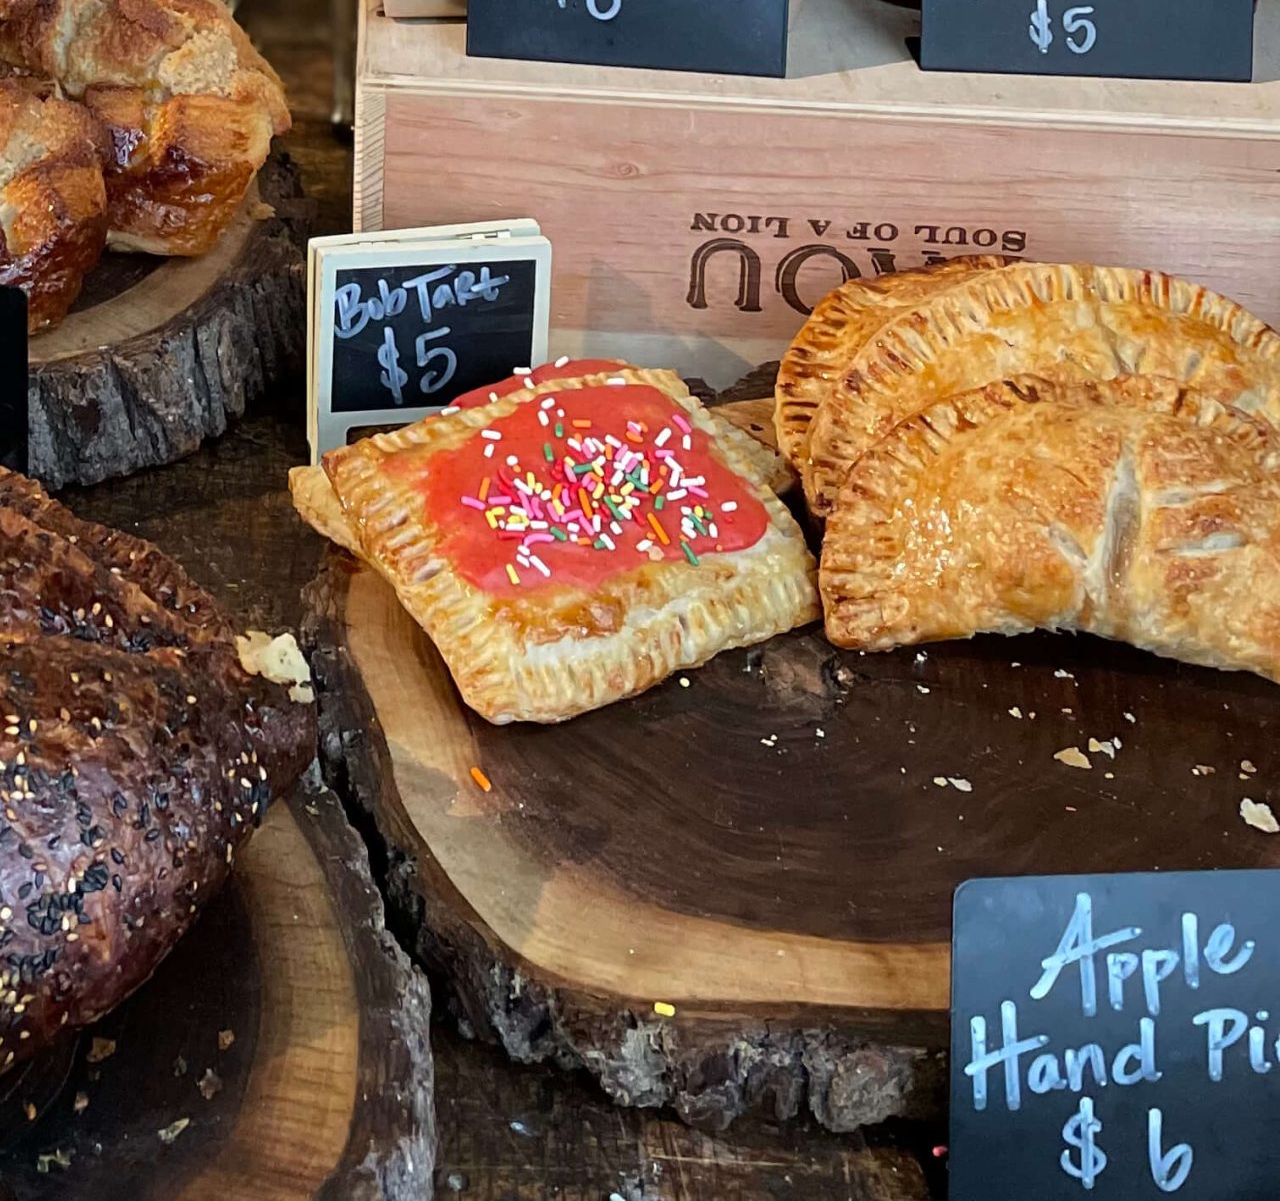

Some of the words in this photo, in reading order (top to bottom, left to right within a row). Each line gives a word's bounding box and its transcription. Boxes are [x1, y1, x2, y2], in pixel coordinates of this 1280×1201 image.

[689, 212, 791, 239] LION
[806, 219, 832, 236] A
[845, 222, 900, 241] OF
[914, 225, 1027, 252] SOUL
[1028, 891, 1256, 1018] Apple
[963, 999, 1164, 1112] Hand
[1191, 1006, 1280, 1082] Pi
